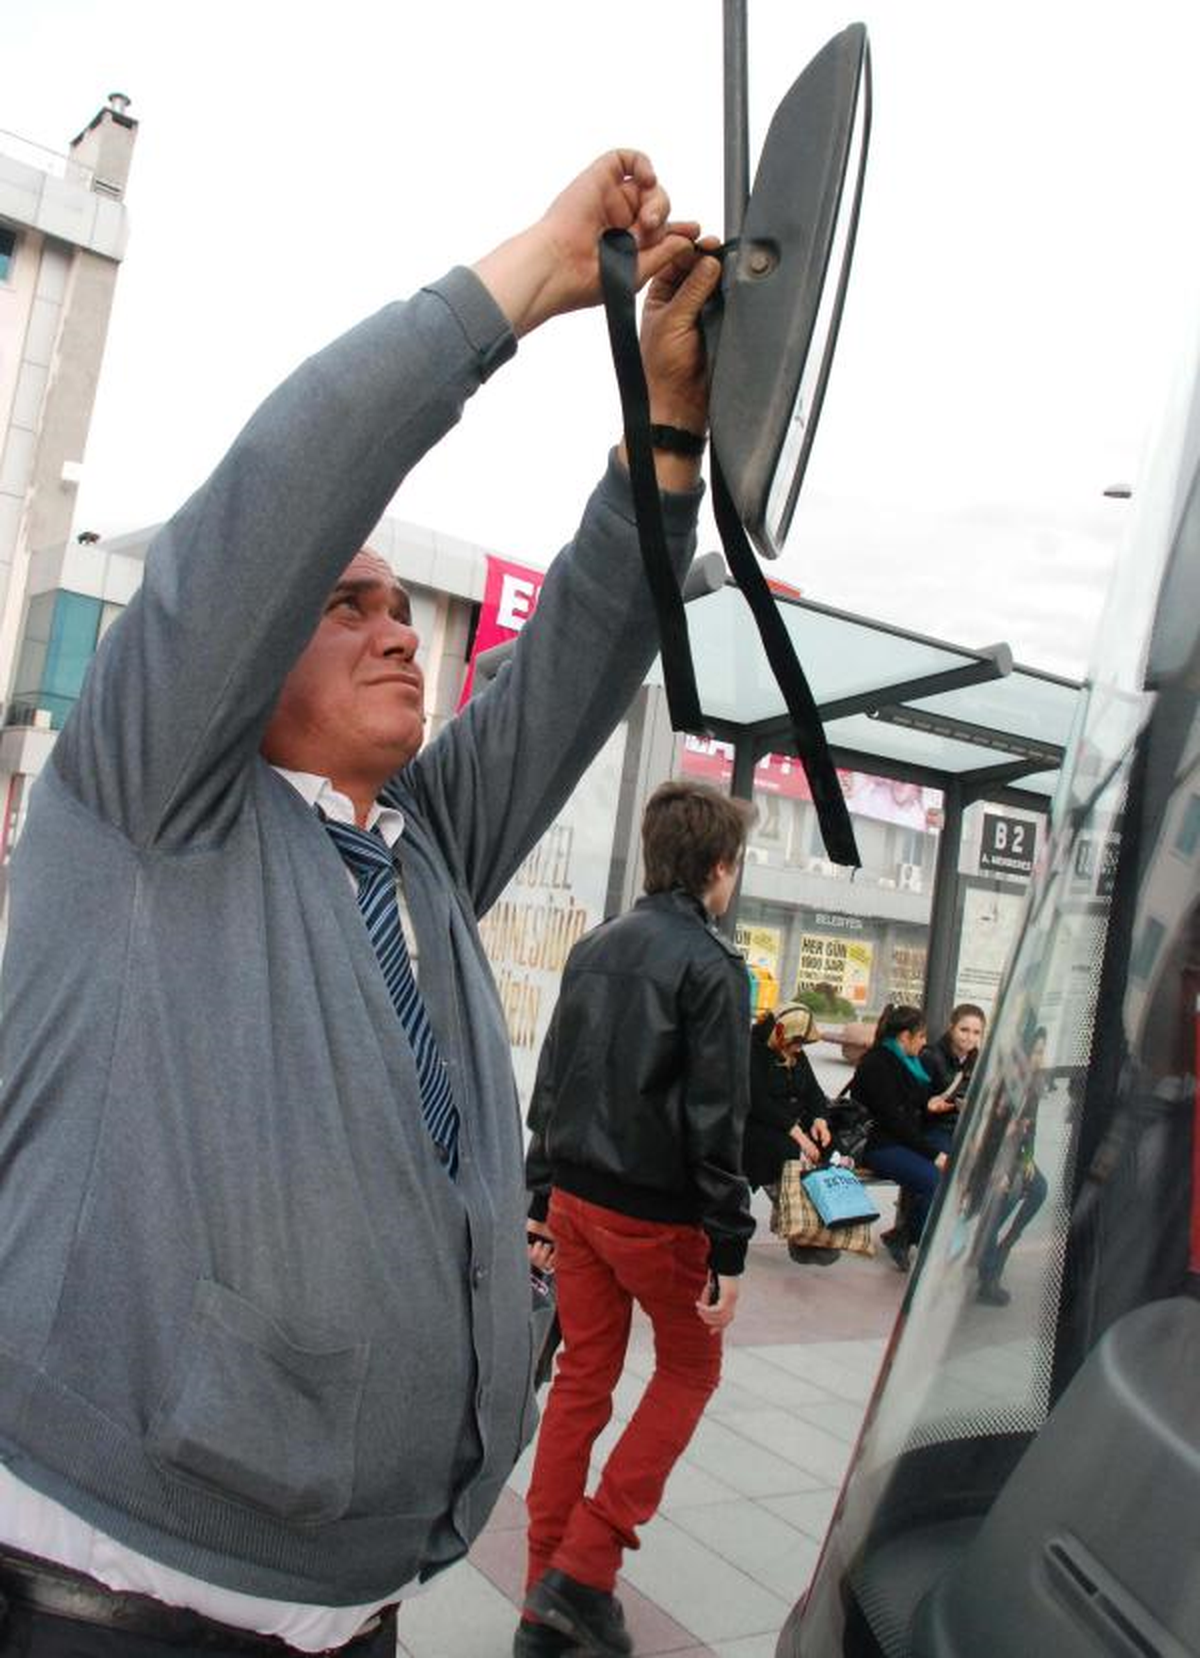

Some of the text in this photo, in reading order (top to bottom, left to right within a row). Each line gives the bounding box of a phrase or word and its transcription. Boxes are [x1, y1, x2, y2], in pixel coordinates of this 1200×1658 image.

[994, 822, 1025, 853] B 2
[802, 937, 847, 959] HER GÜN
